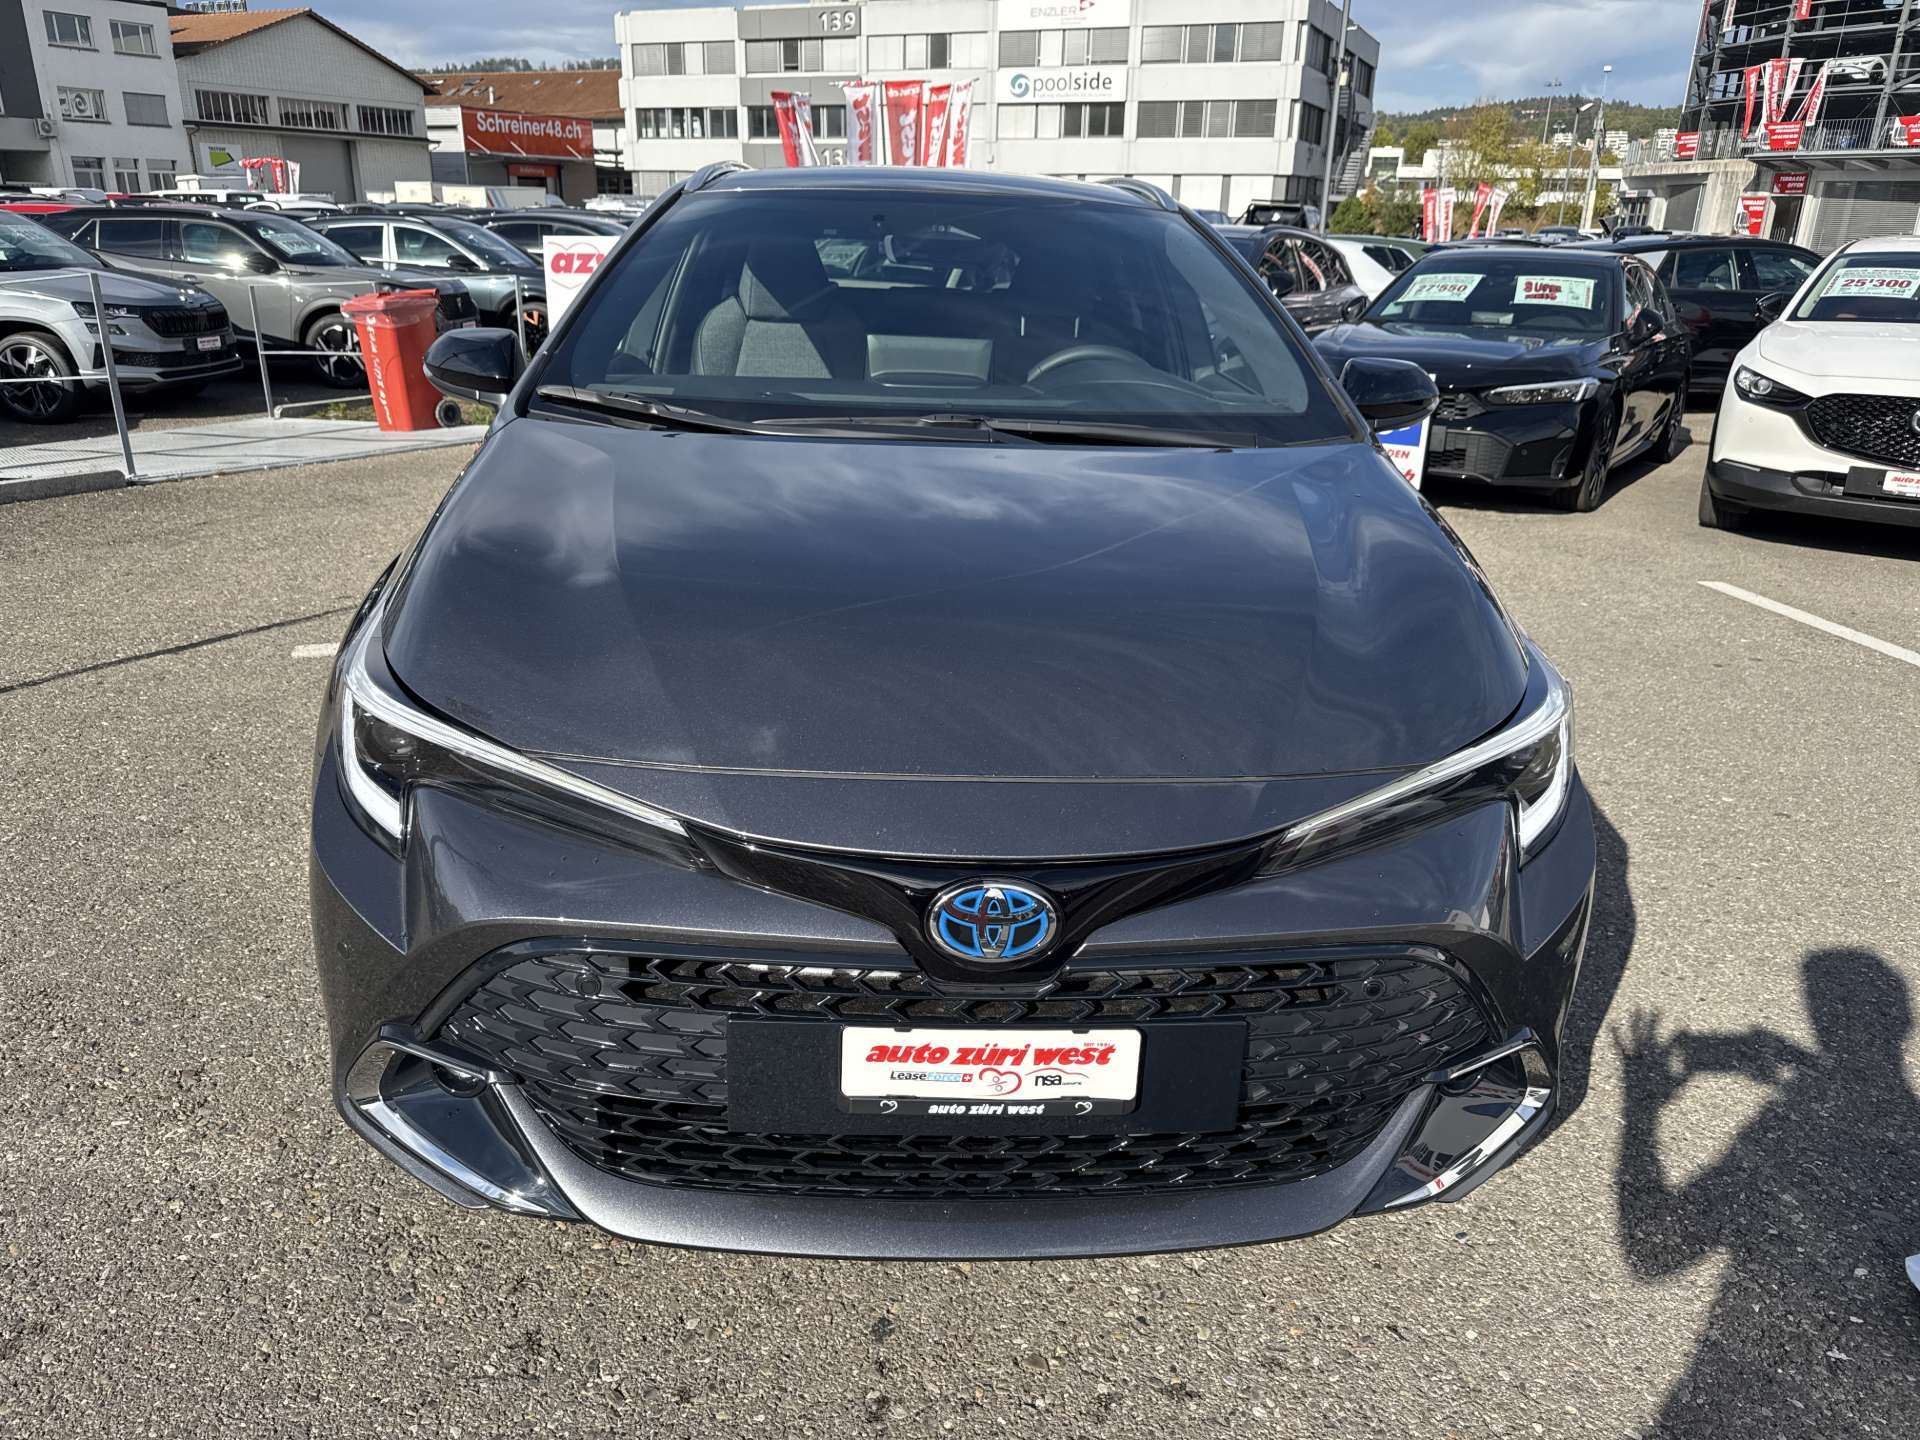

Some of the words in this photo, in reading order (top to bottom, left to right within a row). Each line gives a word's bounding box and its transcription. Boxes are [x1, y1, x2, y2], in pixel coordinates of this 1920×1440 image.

[1030, 6, 1077, 18] ENZLER
[819, 11, 856, 32] 139
[1033, 72, 1113, 98] poolside
[476, 111, 582, 139] Schreiner48.ch
[1841, 279, 1912, 289] 25'300
[866, 1043, 950, 1064] auto
[950, 1043, 1031, 1066] züri
[1033, 1044, 1116, 1066] west
[1034, 1074, 1062, 1087] nsa
[928, 1104, 966, 1115] auto
[968, 1102, 1003, 1115] züri
[1007, 1104, 1046, 1115] west
